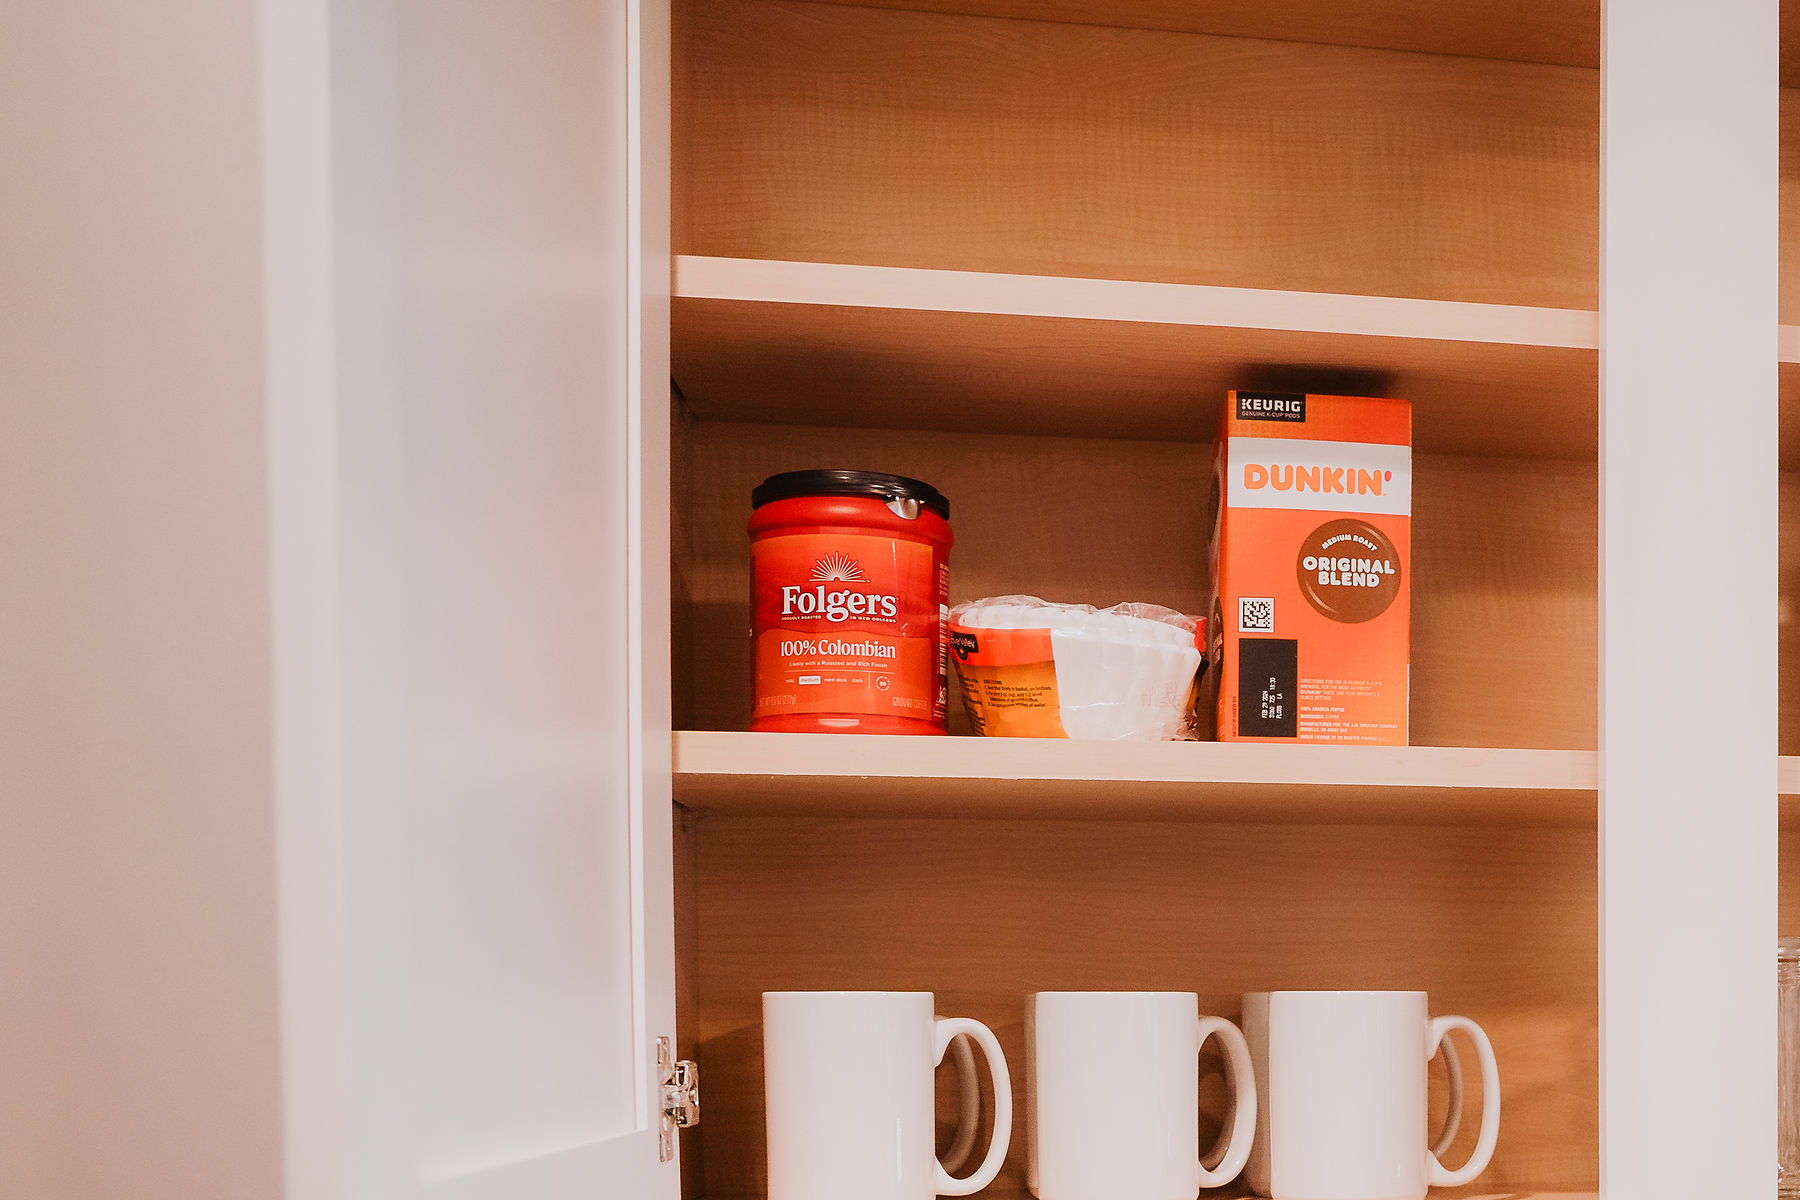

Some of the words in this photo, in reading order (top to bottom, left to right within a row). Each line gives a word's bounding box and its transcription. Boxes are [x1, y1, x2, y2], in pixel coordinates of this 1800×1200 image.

[1241, 398, 1301, 412] KEURIG
[1244, 463, 1392, 497] DUNKIN'
[1321, 534, 1352, 550] MEDIUM
[1352, 535, 1378, 552] ROAST
[1302, 556, 1395, 574] ORIGINAL
[1318, 571, 1380, 587] BLEND
[781, 585, 897, 622] Folgers
[781, 640, 817, 657] 100%
[818, 639, 896, 658] Colombian
